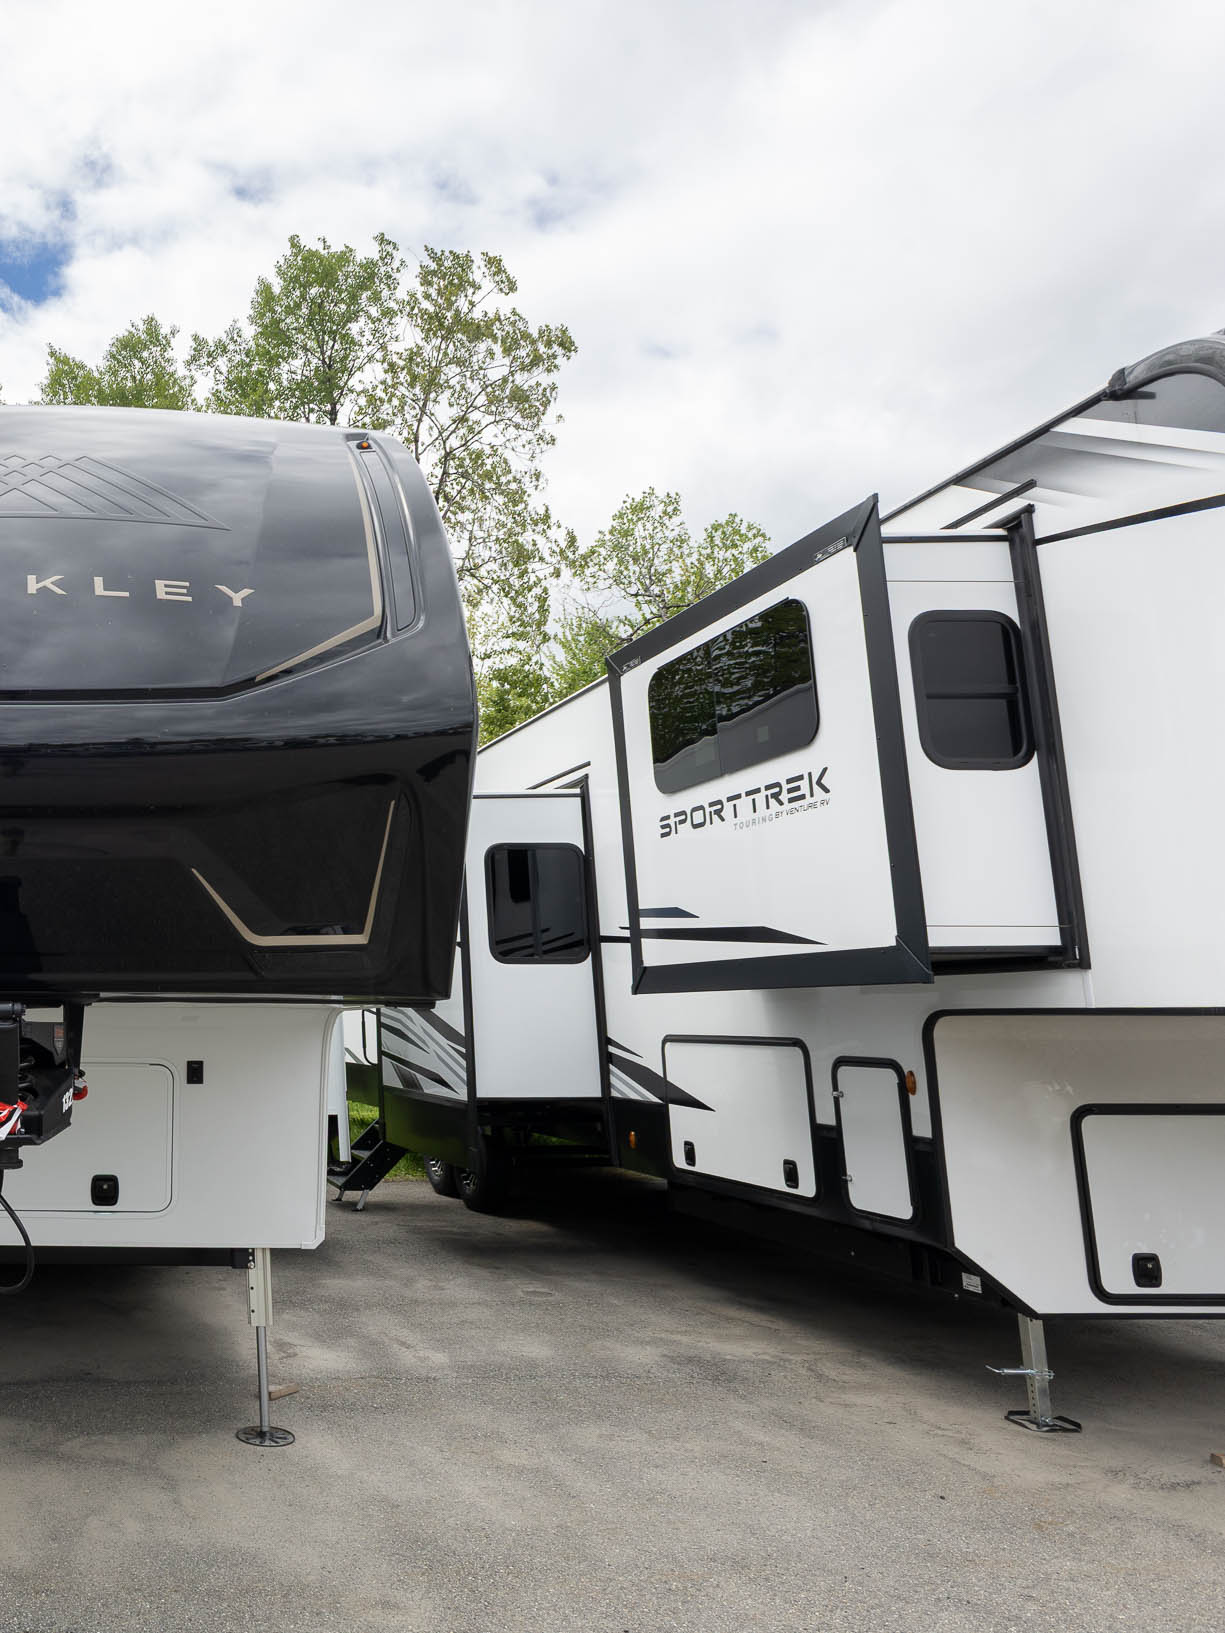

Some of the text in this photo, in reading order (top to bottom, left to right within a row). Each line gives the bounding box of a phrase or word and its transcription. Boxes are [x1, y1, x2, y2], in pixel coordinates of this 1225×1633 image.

[659, 766, 831, 838] SPORTTREK
[733, 798, 831, 831] TOURING BY VENTURE RV
